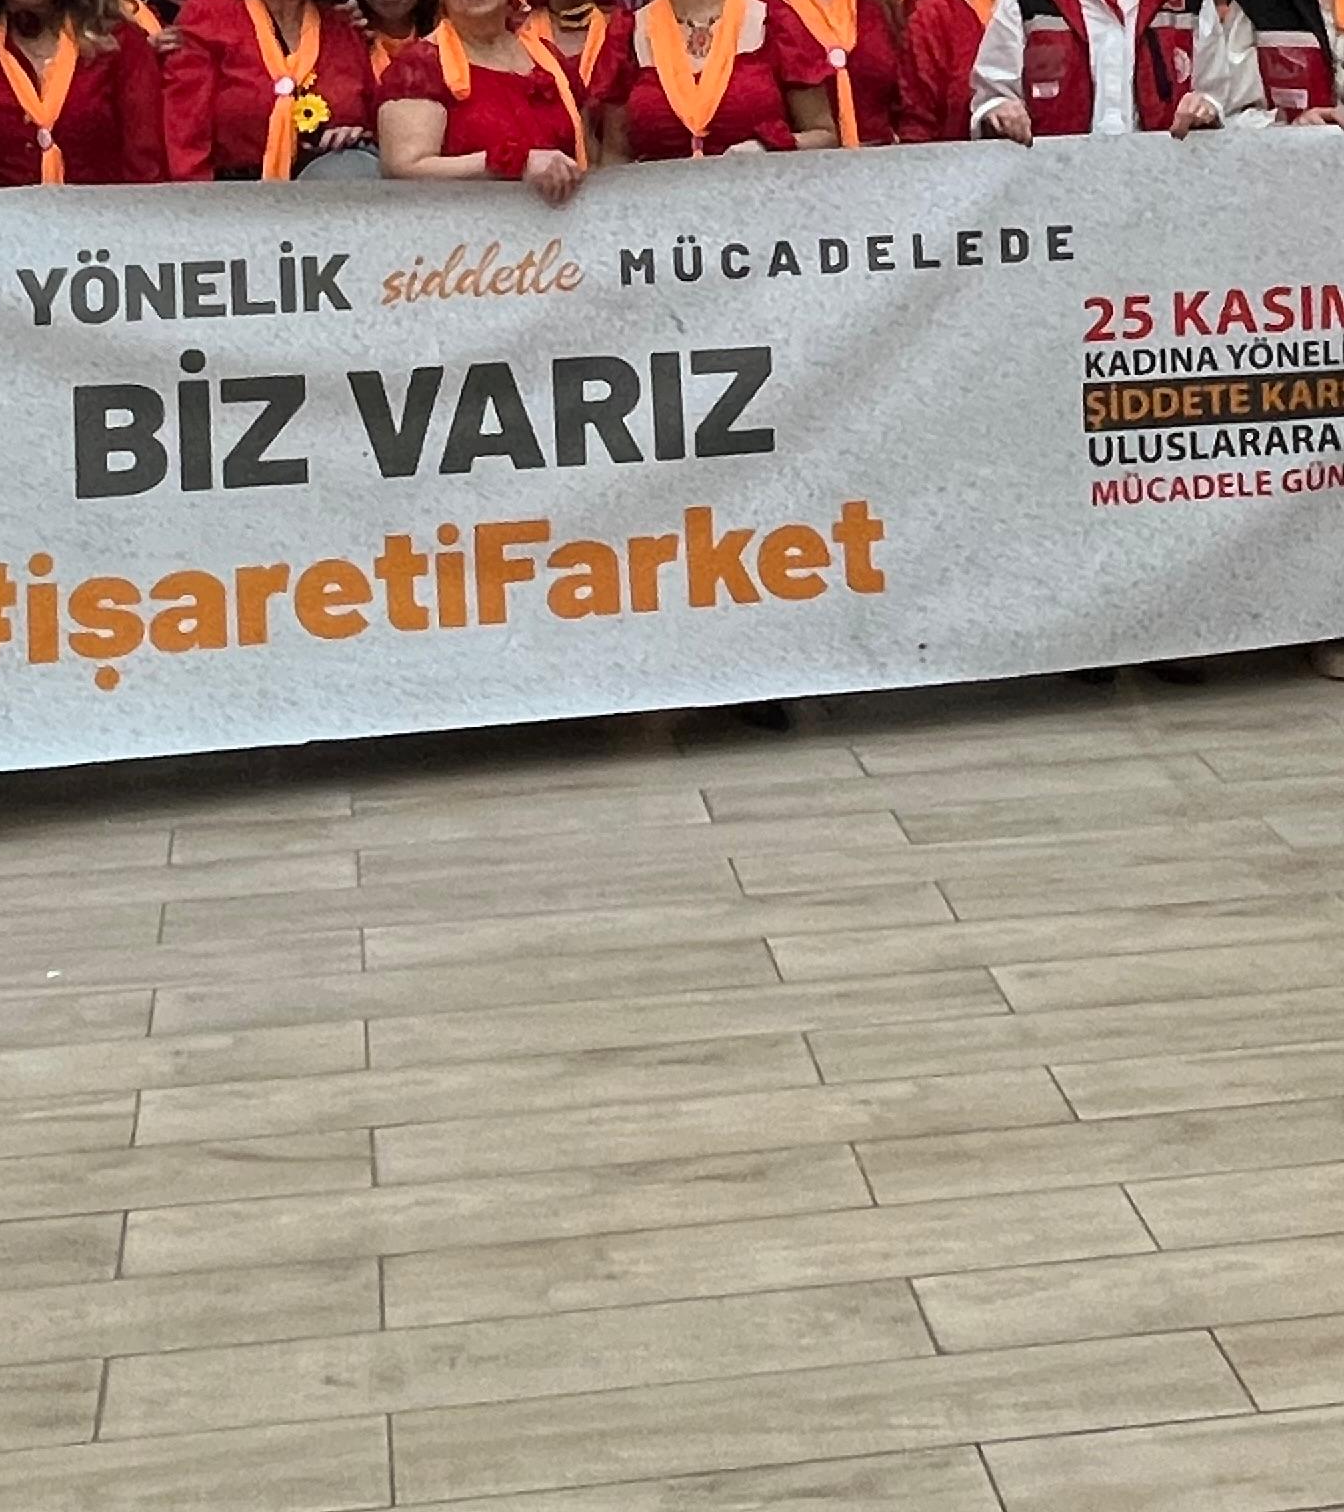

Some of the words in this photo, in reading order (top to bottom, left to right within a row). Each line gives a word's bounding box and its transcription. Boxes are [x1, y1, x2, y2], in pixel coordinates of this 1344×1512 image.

[16, 240, 353, 326] YÖNELİK
[619, 225, 1075, 286] MÜCADELEDE
[1083, 294, 1154, 343] 25
[1085, 346, 1220, 379] KADINA
[73, 348, 309, 500] BİZ
[346, 346, 776, 479] VARIZ
[1085, 382, 1252, 430] ŞİDDETE
[1091, 469, 1273, 507] MÜCADELE
